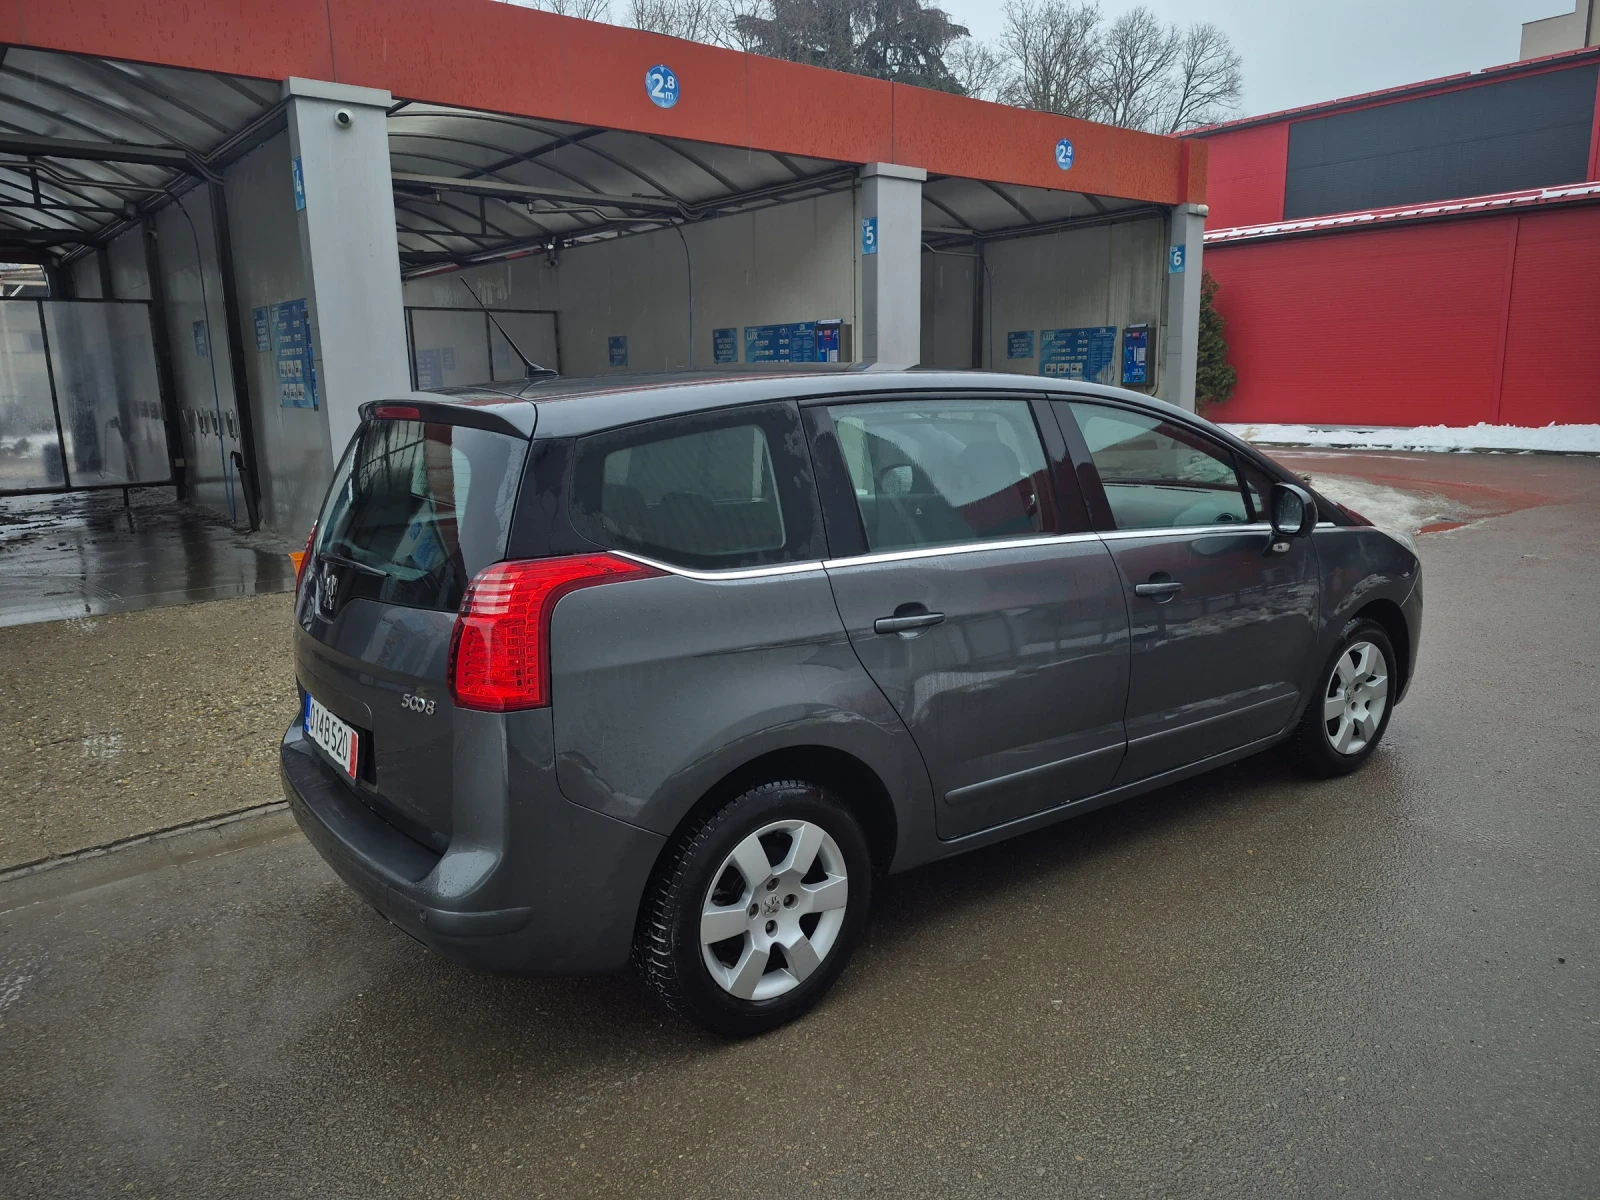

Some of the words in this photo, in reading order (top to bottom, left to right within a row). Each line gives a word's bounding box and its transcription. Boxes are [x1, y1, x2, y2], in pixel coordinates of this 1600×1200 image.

[296, 170, 302, 195] 4
[866, 225, 874, 245] 5
[1173, 251, 1182, 266] 6
[746, 331, 758, 340] LUX
[1042, 333, 1055, 341] LUX
[401, 693, 435, 716] 5008
